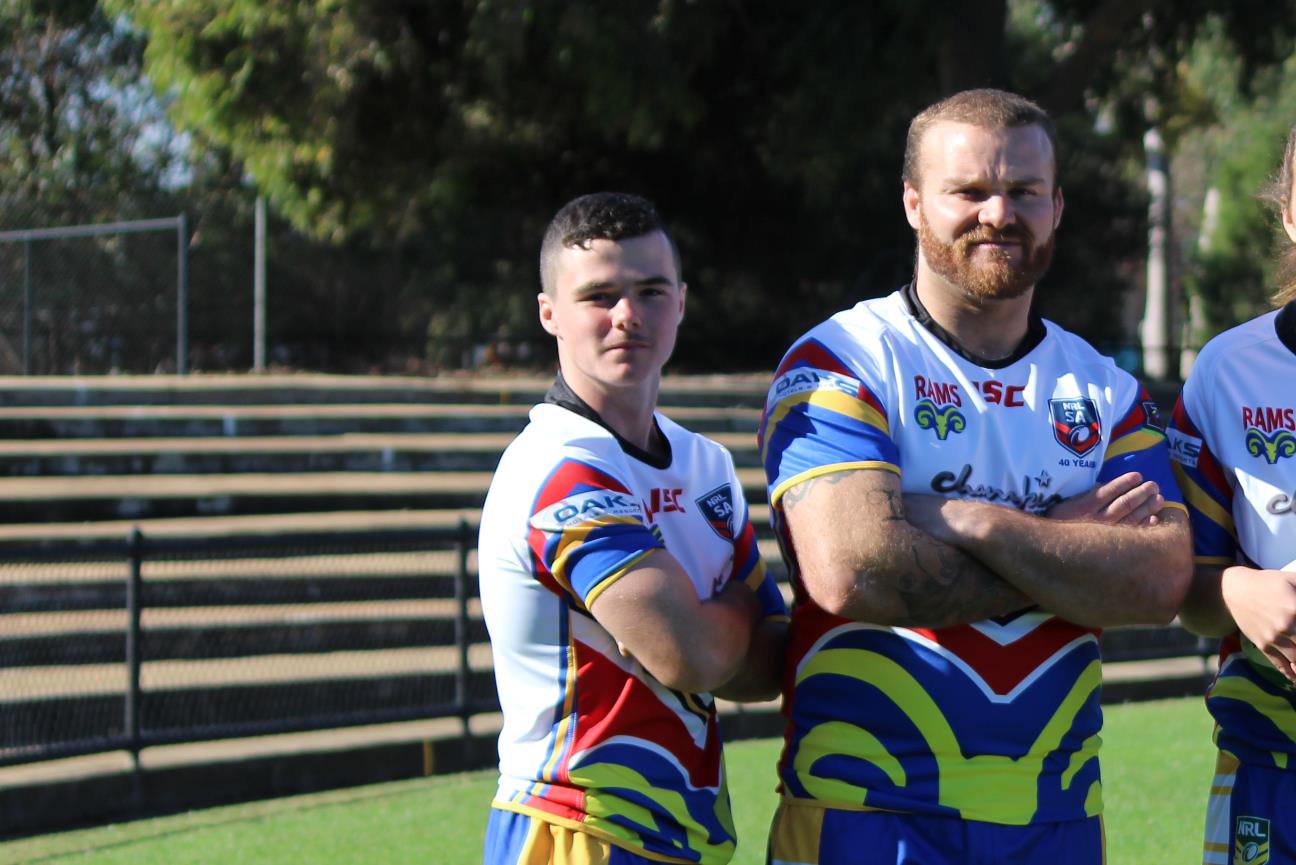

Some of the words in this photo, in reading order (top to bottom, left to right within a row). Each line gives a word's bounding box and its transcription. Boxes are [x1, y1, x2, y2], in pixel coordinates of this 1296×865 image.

[914, 375, 962, 407] RAMS
[1063, 402, 1085, 411] NRL
[1067, 412, 1086, 423] SA
[1243, 406, 1296, 432] RAMS
[1238, 821, 1266, 838] NRL
